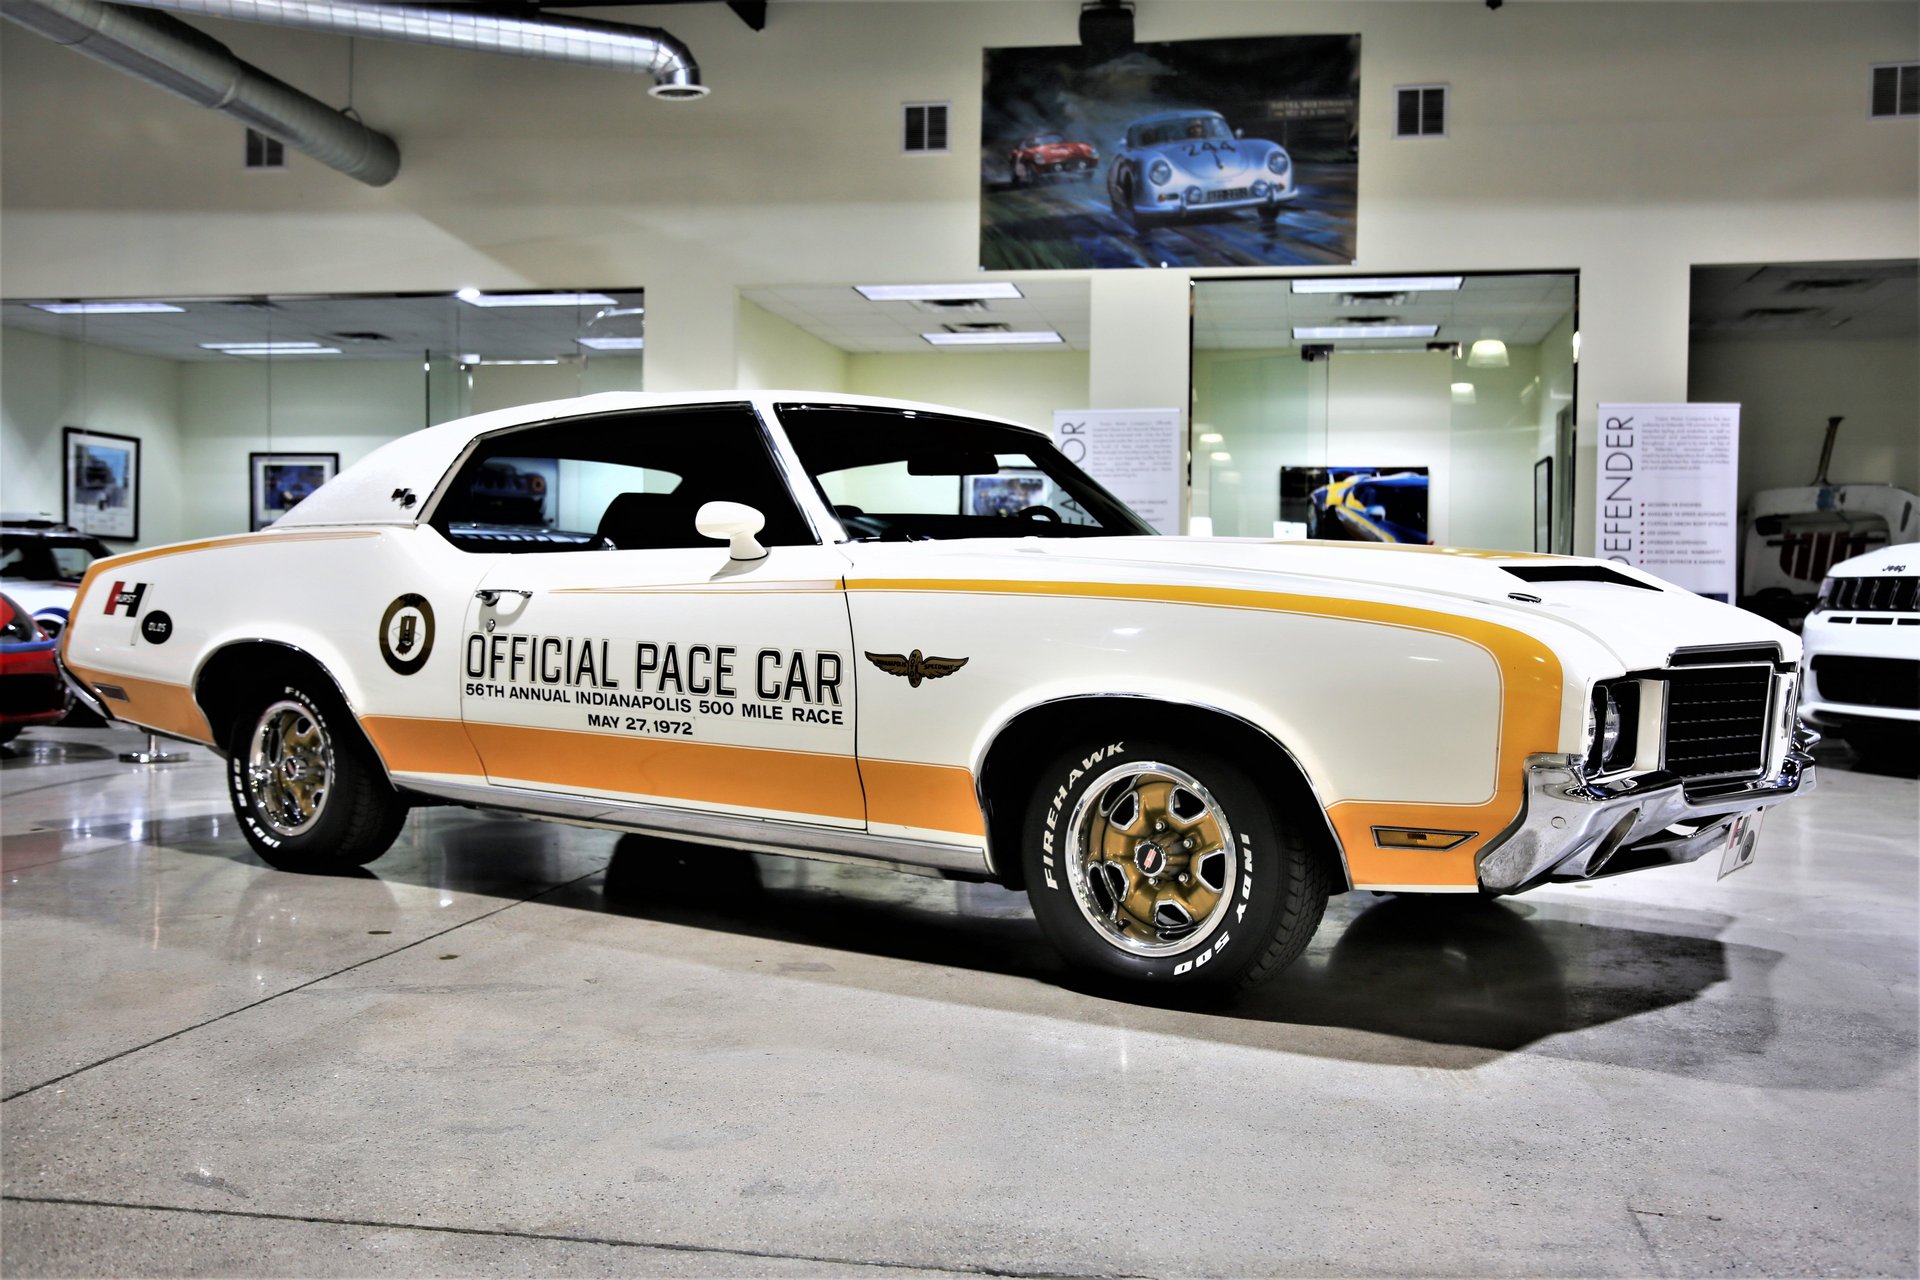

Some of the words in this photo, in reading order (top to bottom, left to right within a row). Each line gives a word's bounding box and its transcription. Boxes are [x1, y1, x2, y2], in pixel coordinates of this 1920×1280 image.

[466, 631, 620, 690] OFFICIAL
[635, 640, 738, 699] PACE
[755, 647, 844, 707] CAR
[466, 684, 505, 698] 56TH
[509, 686, 571, 704] ANNUAL
[576, 691, 692, 713] INDIANAPOLIS
[699, 700, 734, 716] 500
[742, 703, 783, 720] MILE
[792, 707, 844, 725] RACE
[588, 713, 620, 729] MAY
[1043, 741, 1125, 890] FIREHAWK
[1236, 832, 1253, 924] INDY
[1173, 931, 1230, 976] 500
